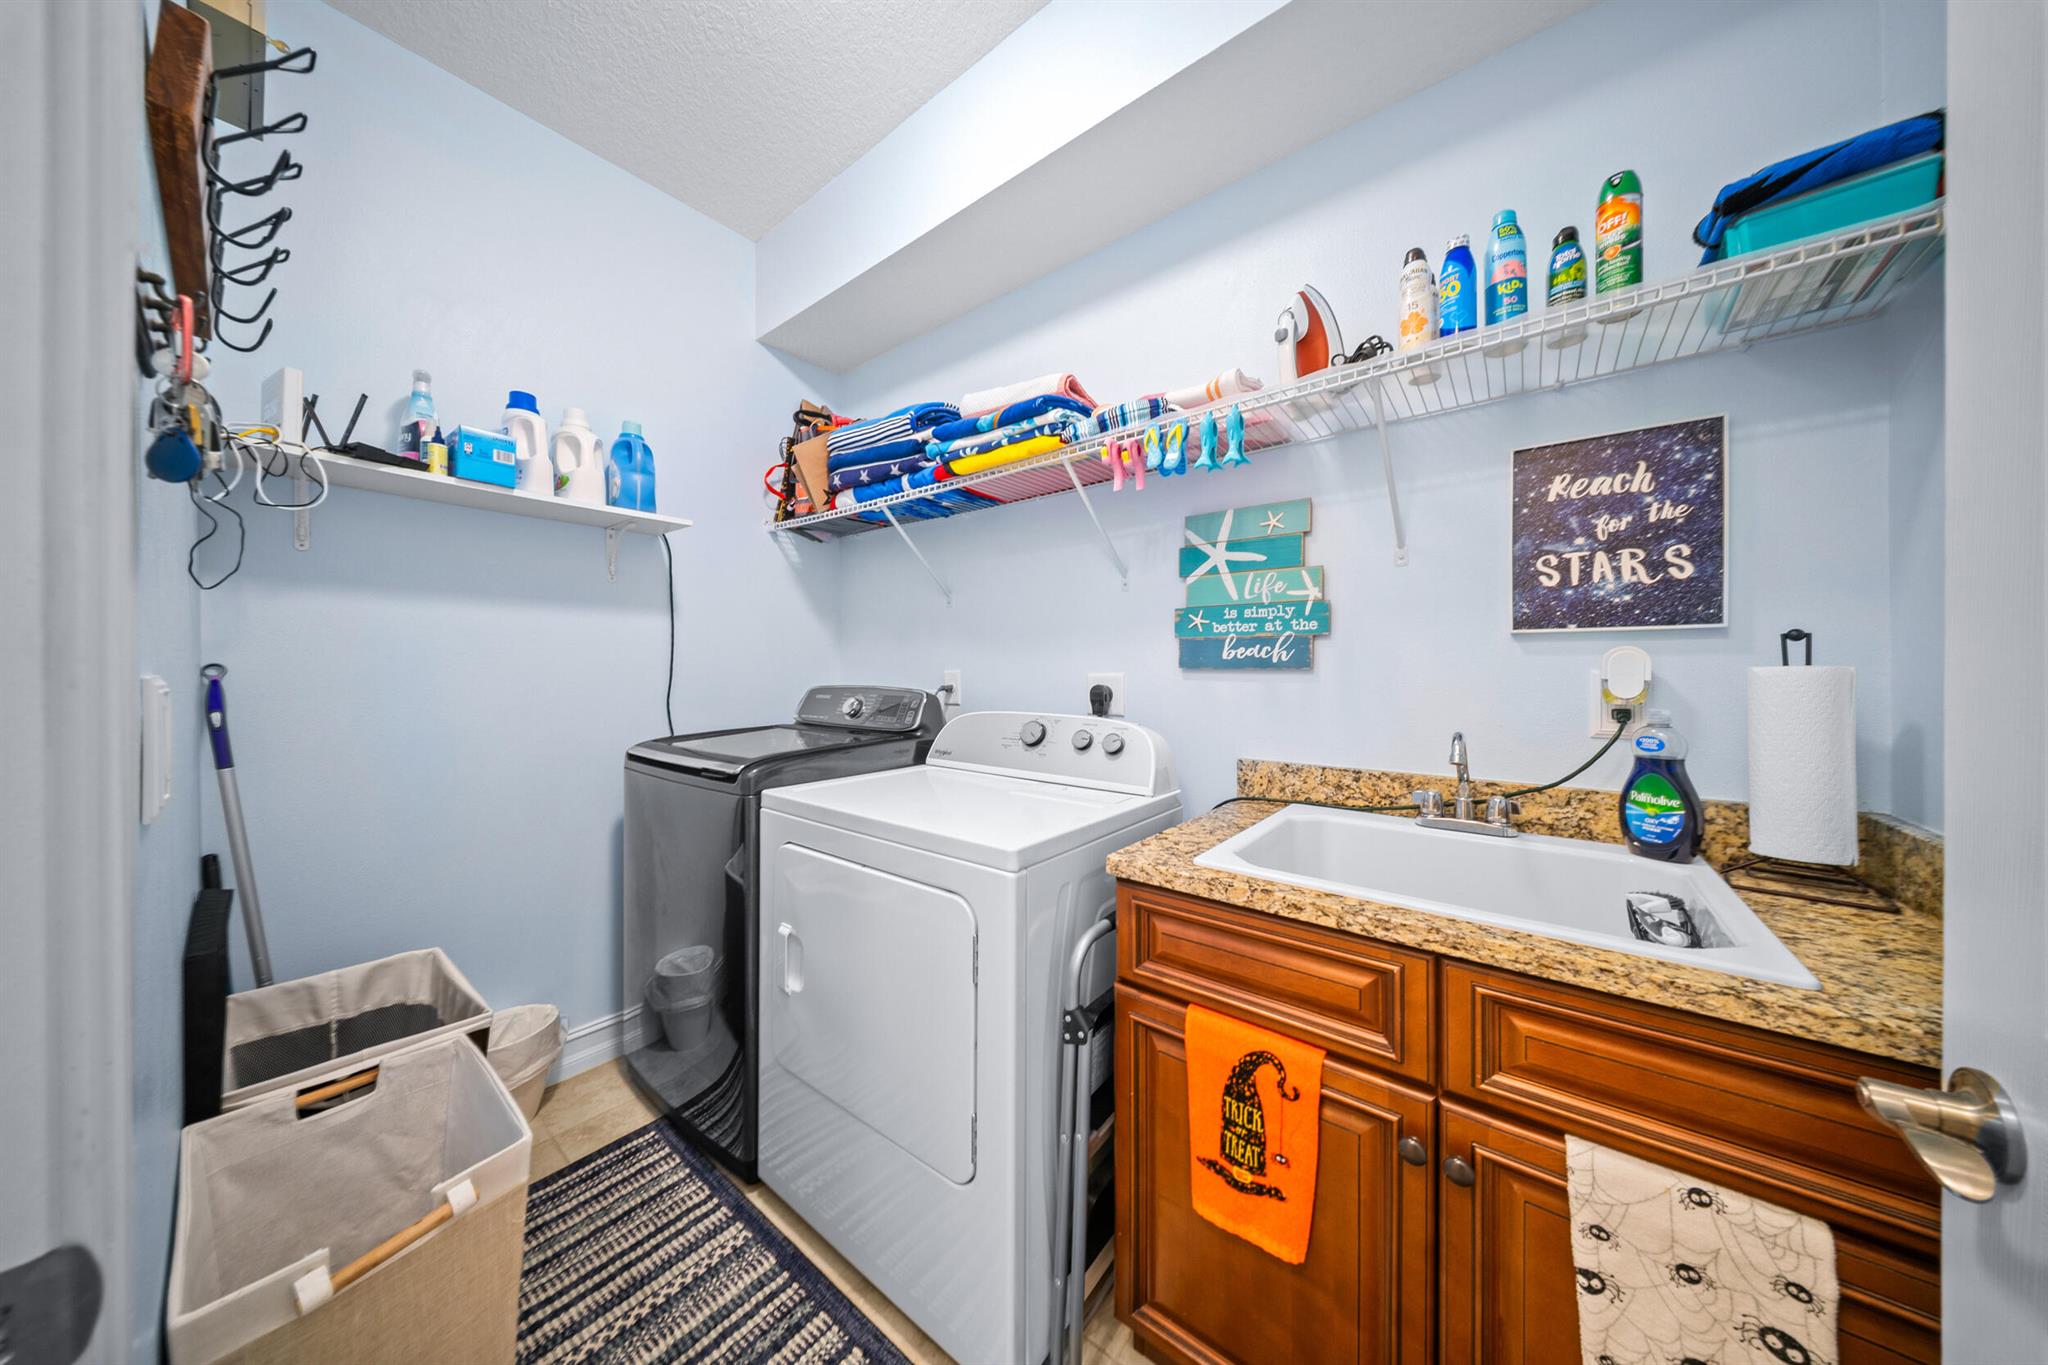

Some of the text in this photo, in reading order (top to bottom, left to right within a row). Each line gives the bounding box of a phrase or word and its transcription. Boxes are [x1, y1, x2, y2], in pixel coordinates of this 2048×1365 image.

[1599, 211, 1628, 234] OFF!
[1547, 460, 1656, 502] Reach
[1595, 500, 1695, 541] for the
[1535, 543, 1695, 587] STARS
[1212, 618, 1318, 633] better at the
[1223, 605, 1297, 619] is simply
[1222, 631, 1296, 664] beach
[1631, 790, 1681, 808] Palmolive
[1223, 1095, 1264, 1134] TRICK
[1224, 1130, 1261, 1167] TREAT
